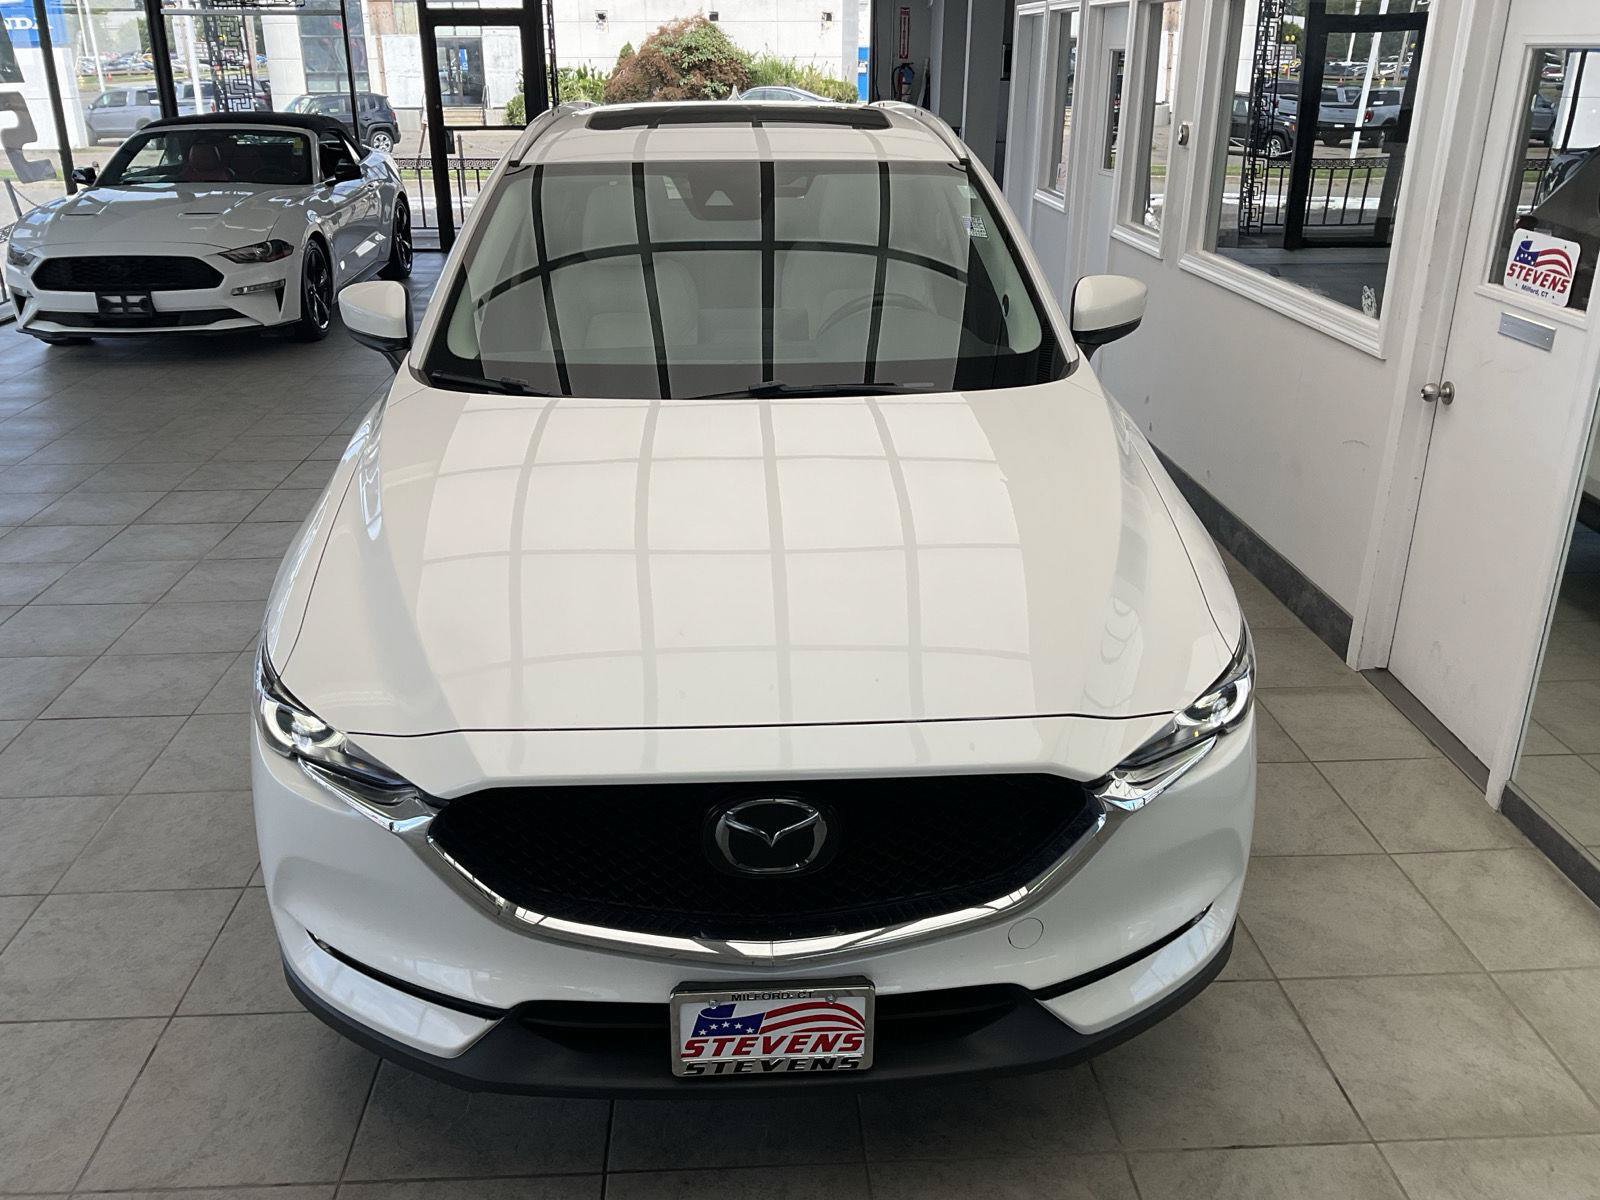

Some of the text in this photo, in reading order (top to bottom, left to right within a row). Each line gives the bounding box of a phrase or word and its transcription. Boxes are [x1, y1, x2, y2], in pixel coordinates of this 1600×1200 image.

[1507, 262, 1570, 294] STEVENS
[797, 991, 813, 1000] CT
[680, 1033, 865, 1059] STEVENS
[684, 1057, 861, 1076] STEVENS
